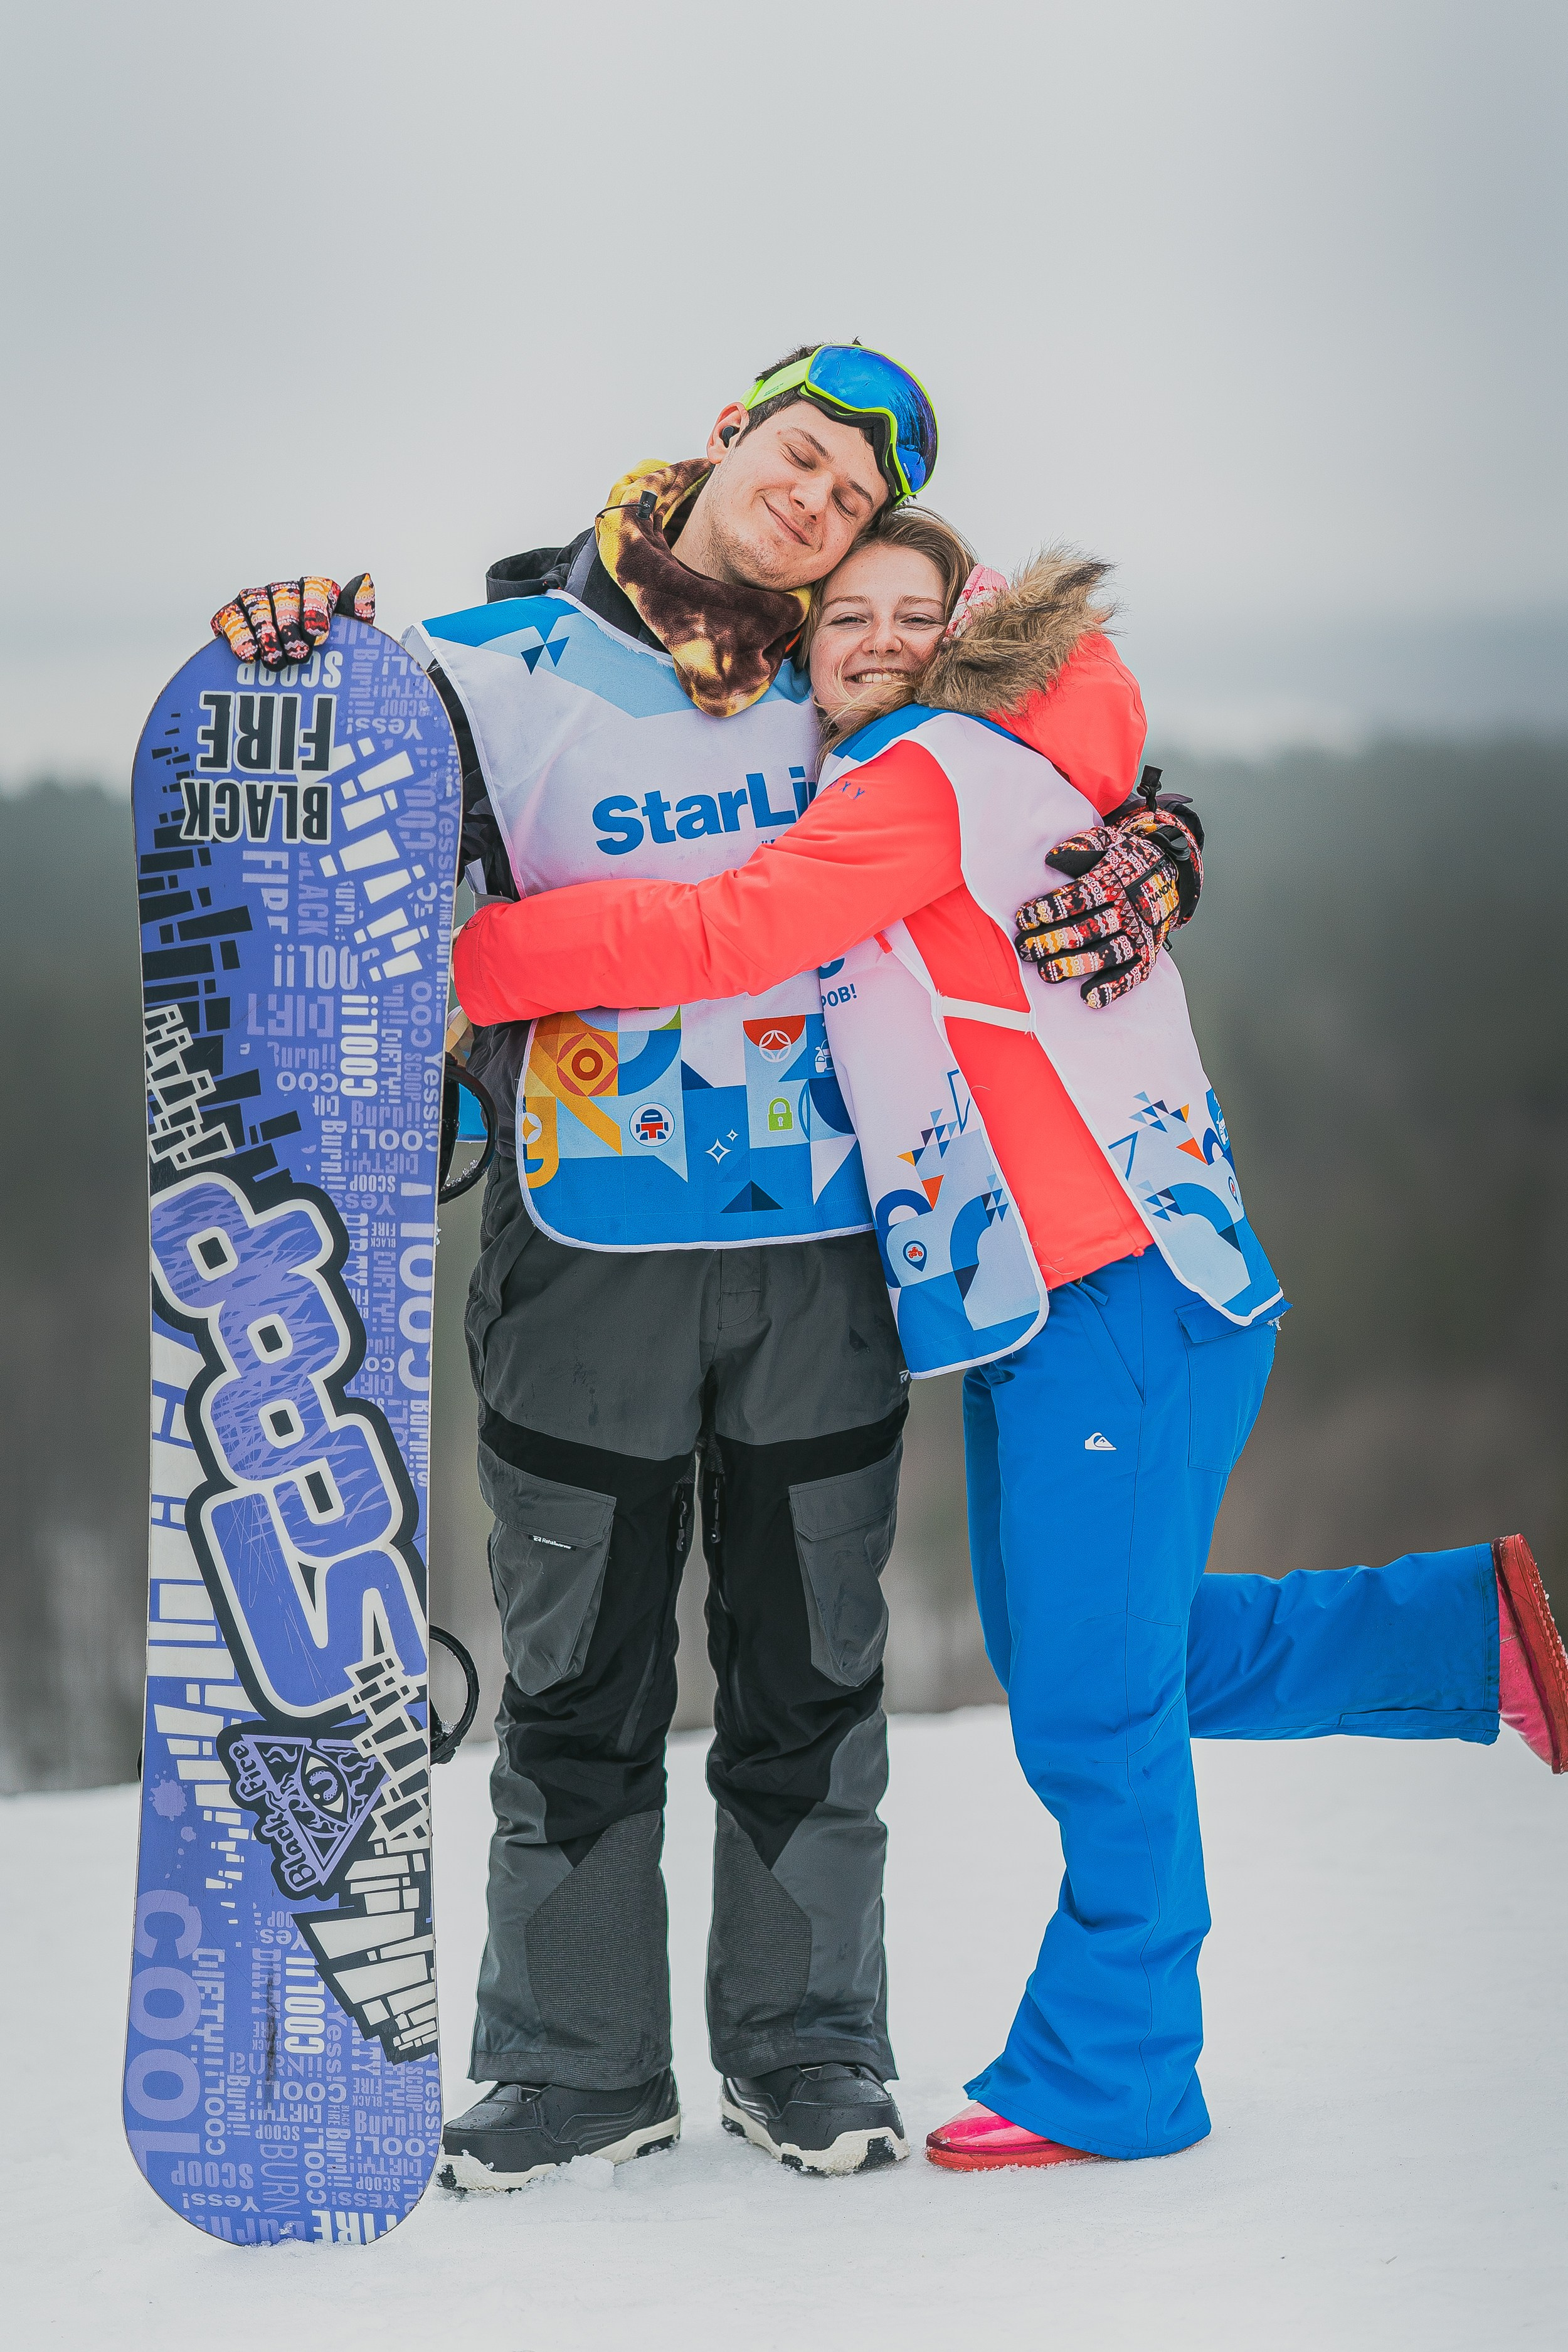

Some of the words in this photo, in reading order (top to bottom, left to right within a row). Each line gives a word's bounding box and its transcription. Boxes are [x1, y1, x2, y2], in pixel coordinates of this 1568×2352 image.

[236, 650, 343, 688] SCOOP
[198, 691, 337, 773] FIRE
[346, 717, 423, 740] Yess!
[180, 779, 331, 844] BLACK
[340, 995, 378, 1098] COOL!!
[380, 1029, 403, 1104] DIRTY!!
[423, 1051, 443, 1129] Yess!
[351, 1128, 438, 1152] COOL!
[320, 1120, 347, 1190] Burn!!
[345, 1152, 419, 1175] DIRTY!!
[349, 1174, 396, 1193] SCOOP
[370, 1237, 396, 1248] BLACK
[371, 1222, 396, 1236] FIRE
[372, 1251, 396, 1332] DIRTY!!
[263, 1812, 318, 1889] Black
[191, 1948, 225, 2065] DIRTY!!
[326, 2008, 347, 2082] Yess!
[256, 2080, 347, 2104] COOL!
[352, 2077, 382, 2095] FIRE
[204, 2070, 226, 2156] COOL!
[226, 2075, 251, 2136] Burn!!
[250, 2101, 322, 2124] DIRTY!!
[352, 2095, 382, 2107] BLACK
[255, 2124, 300, 2141] SCOOP
[355, 2110, 423, 2137] Burn!!
[304, 2126, 327, 2205] COOL!
[326, 2127, 351, 2188] Burn!!
[349, 2155, 422, 2177] DIRTY!!
[171, 2160, 254, 2189] SCOOP
[260, 2144, 301, 2215] BURN
[355, 2176, 401, 2192] SCOOP
[183, 2193, 262, 2213] Yess!
[332, 2191, 400, 2209] YESS!
